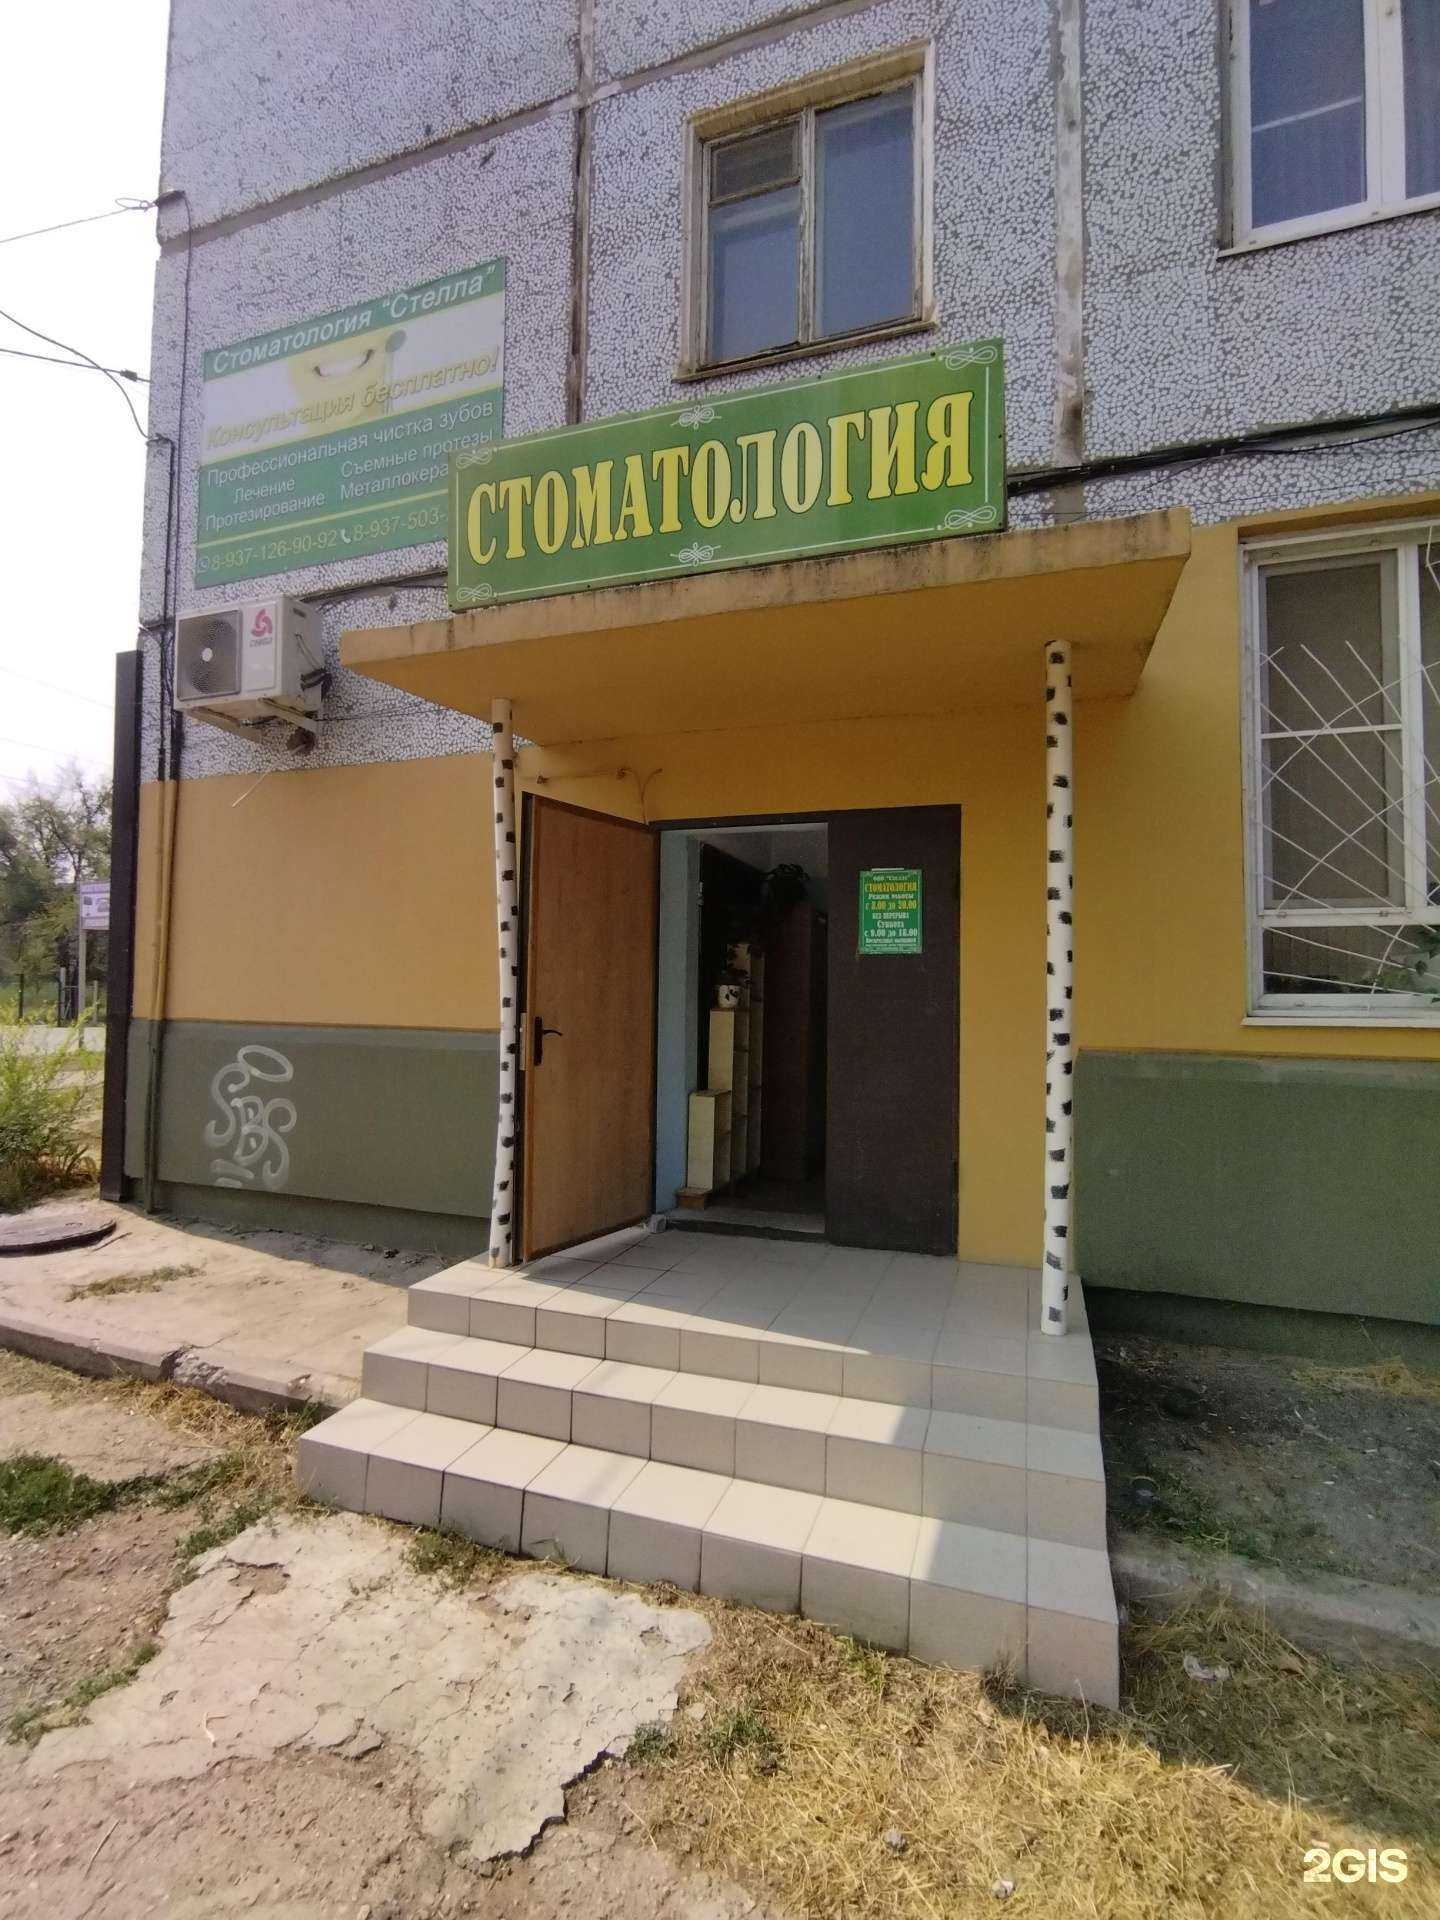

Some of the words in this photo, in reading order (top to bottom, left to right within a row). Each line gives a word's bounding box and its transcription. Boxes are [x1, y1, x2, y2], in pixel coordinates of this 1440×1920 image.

[213, 310, 373, 374] Стоматология
[207, 391, 356, 449] Консультация
[361, 345, 500, 407] бесплатно!
[207, 433, 368, 488] Профессиональная
[373, 417, 433, 443] чистка
[439, 401, 494, 430] зубов
[340, 448, 418, 478] Съемные
[423, 429, 493, 459] протезы
[233, 479, 295, 504] Лечение
[466, 390, 975, 566] СТОМАТОЛОГИЯ
[206, 492, 326, 533] Протезирование
[352, 507, 448, 541] 8-937-503-
